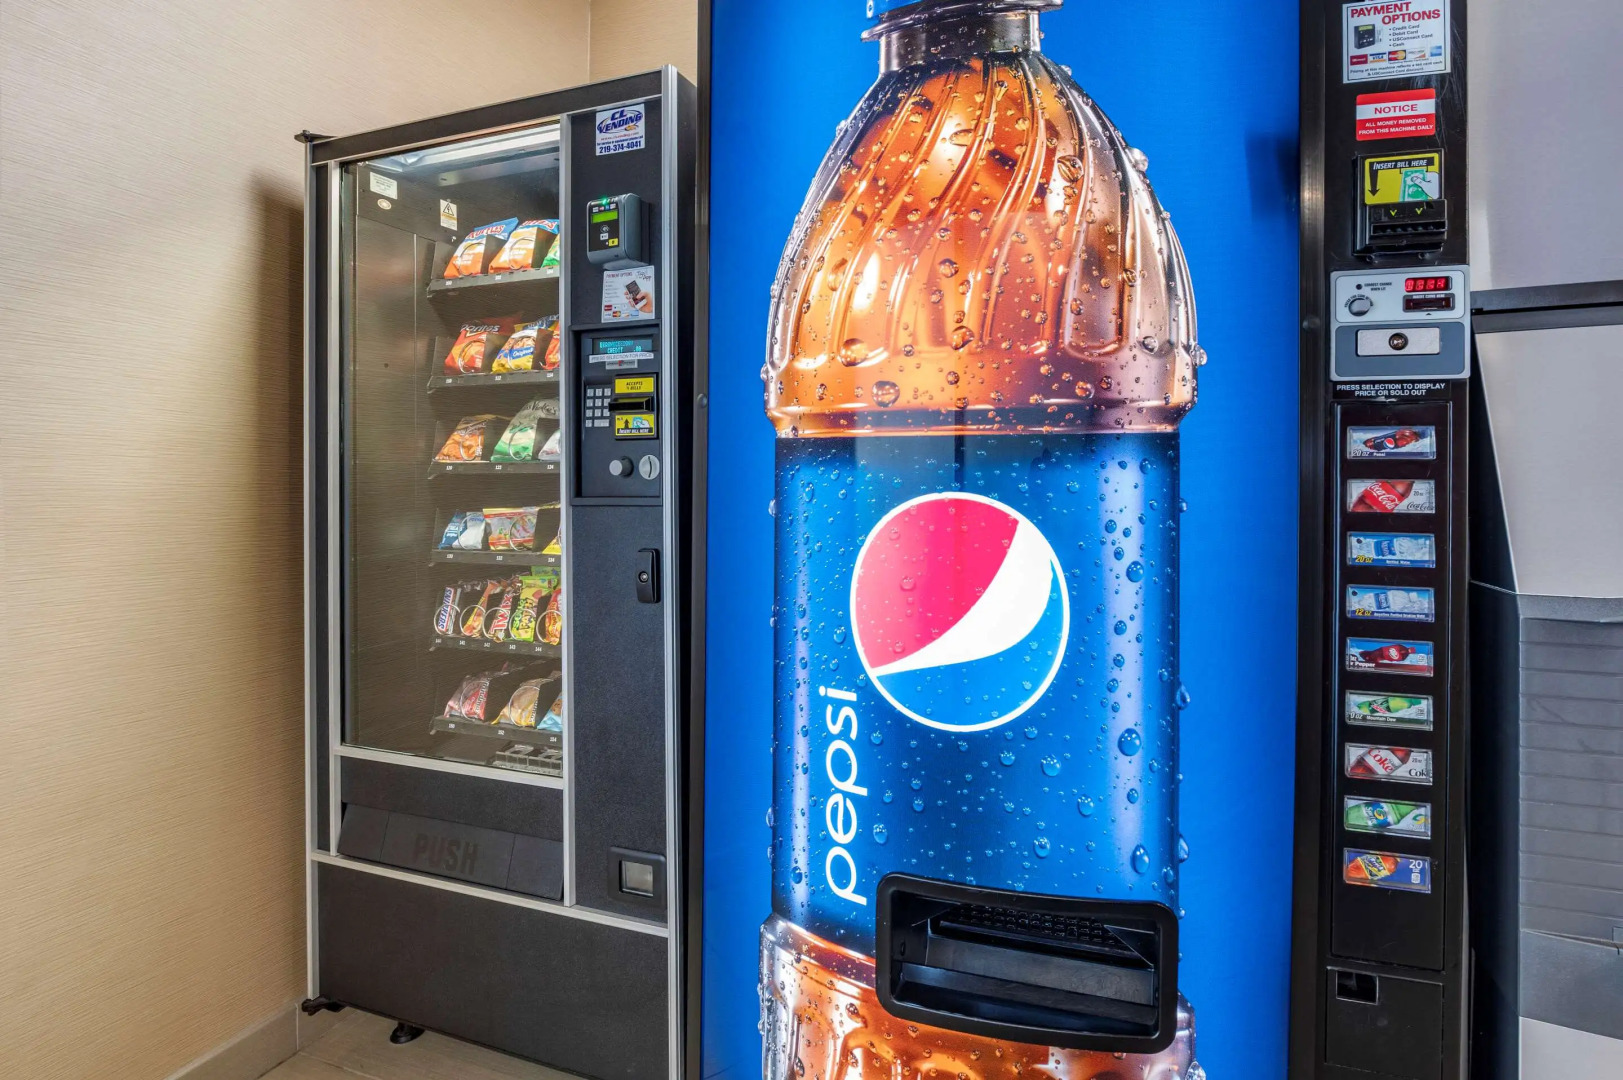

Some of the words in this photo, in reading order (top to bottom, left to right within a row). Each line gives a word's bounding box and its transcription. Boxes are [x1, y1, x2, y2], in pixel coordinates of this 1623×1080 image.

[1350, 2, 1411, 18] PAYMENT
[1382, 9, 1440, 25] OPTIONS
[1374, 104, 1418, 115] NOTICE
[598, 113, 644, 134] VENDING
[599, 141, 641, 153] 219-374-4041
[1368, 749, 1394, 773] Coke
[819, 685, 868, 906] pepsi
[414, 832, 479, 875] PUSH
[1409, 860, 1423, 869] 20
